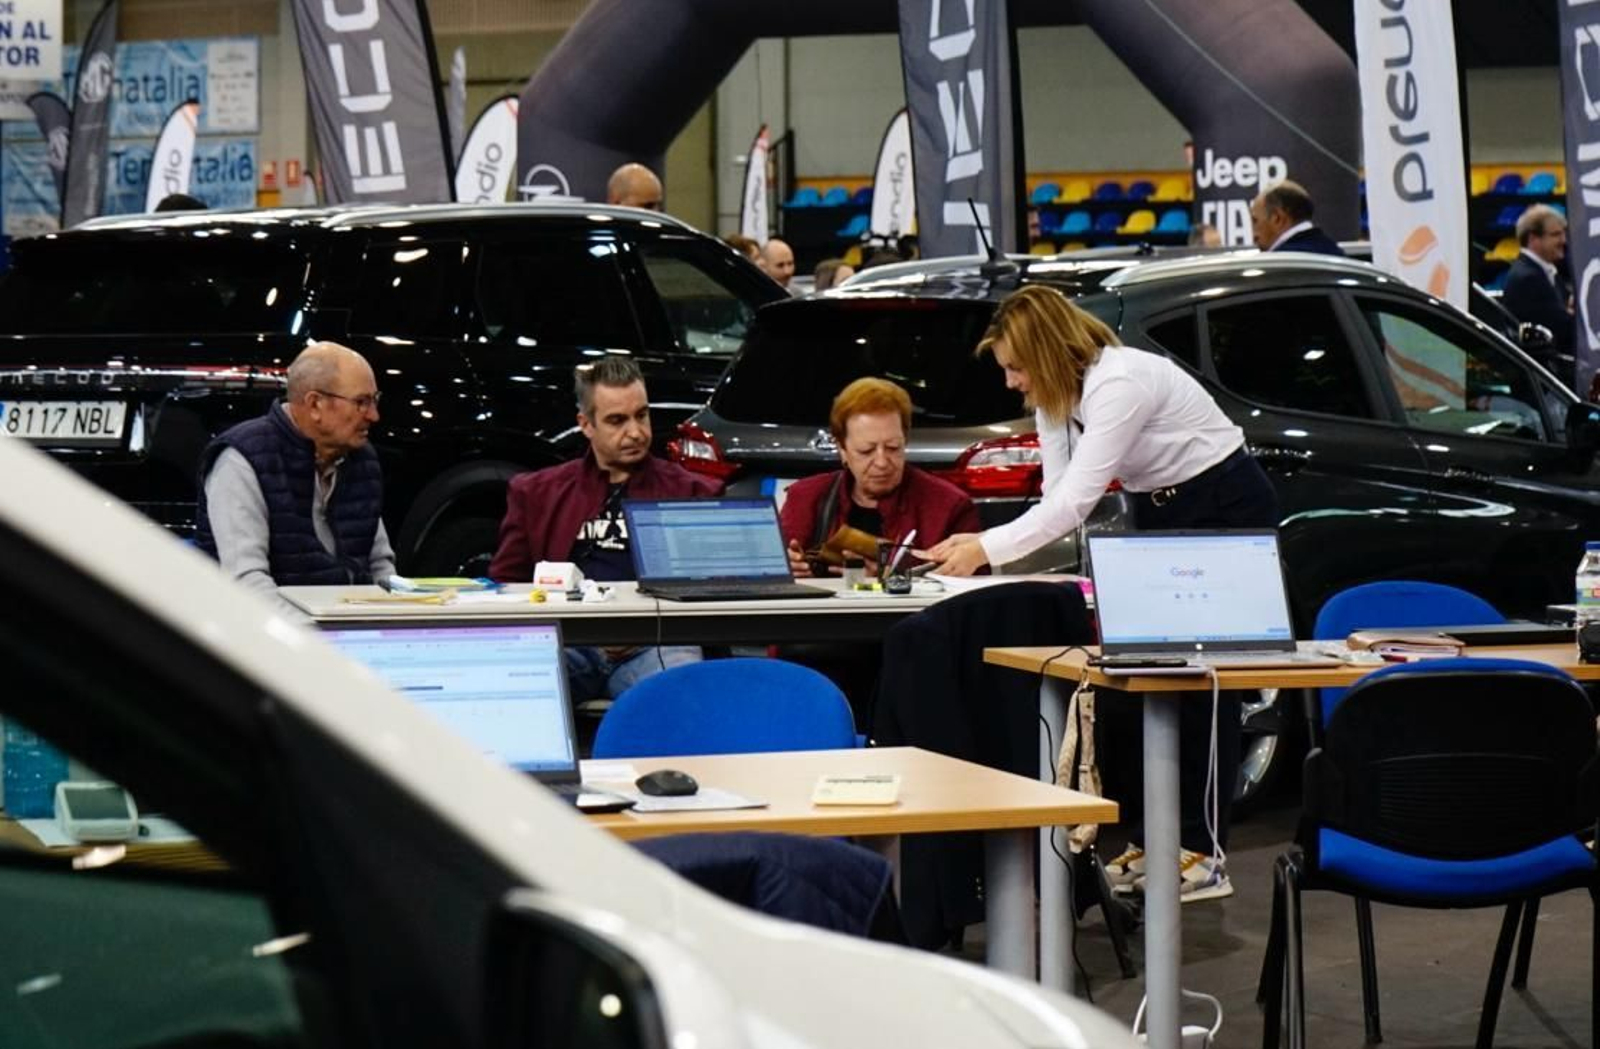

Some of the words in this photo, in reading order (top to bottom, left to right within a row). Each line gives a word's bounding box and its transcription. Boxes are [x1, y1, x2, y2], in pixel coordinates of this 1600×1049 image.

[22, 20, 52, 40] AL
[1196, 148, 1288, 195] Jeep
[1202, 199, 1255, 246] FIA
[6, 407, 68, 433] 8117
[73, 407, 116, 434] NBL
